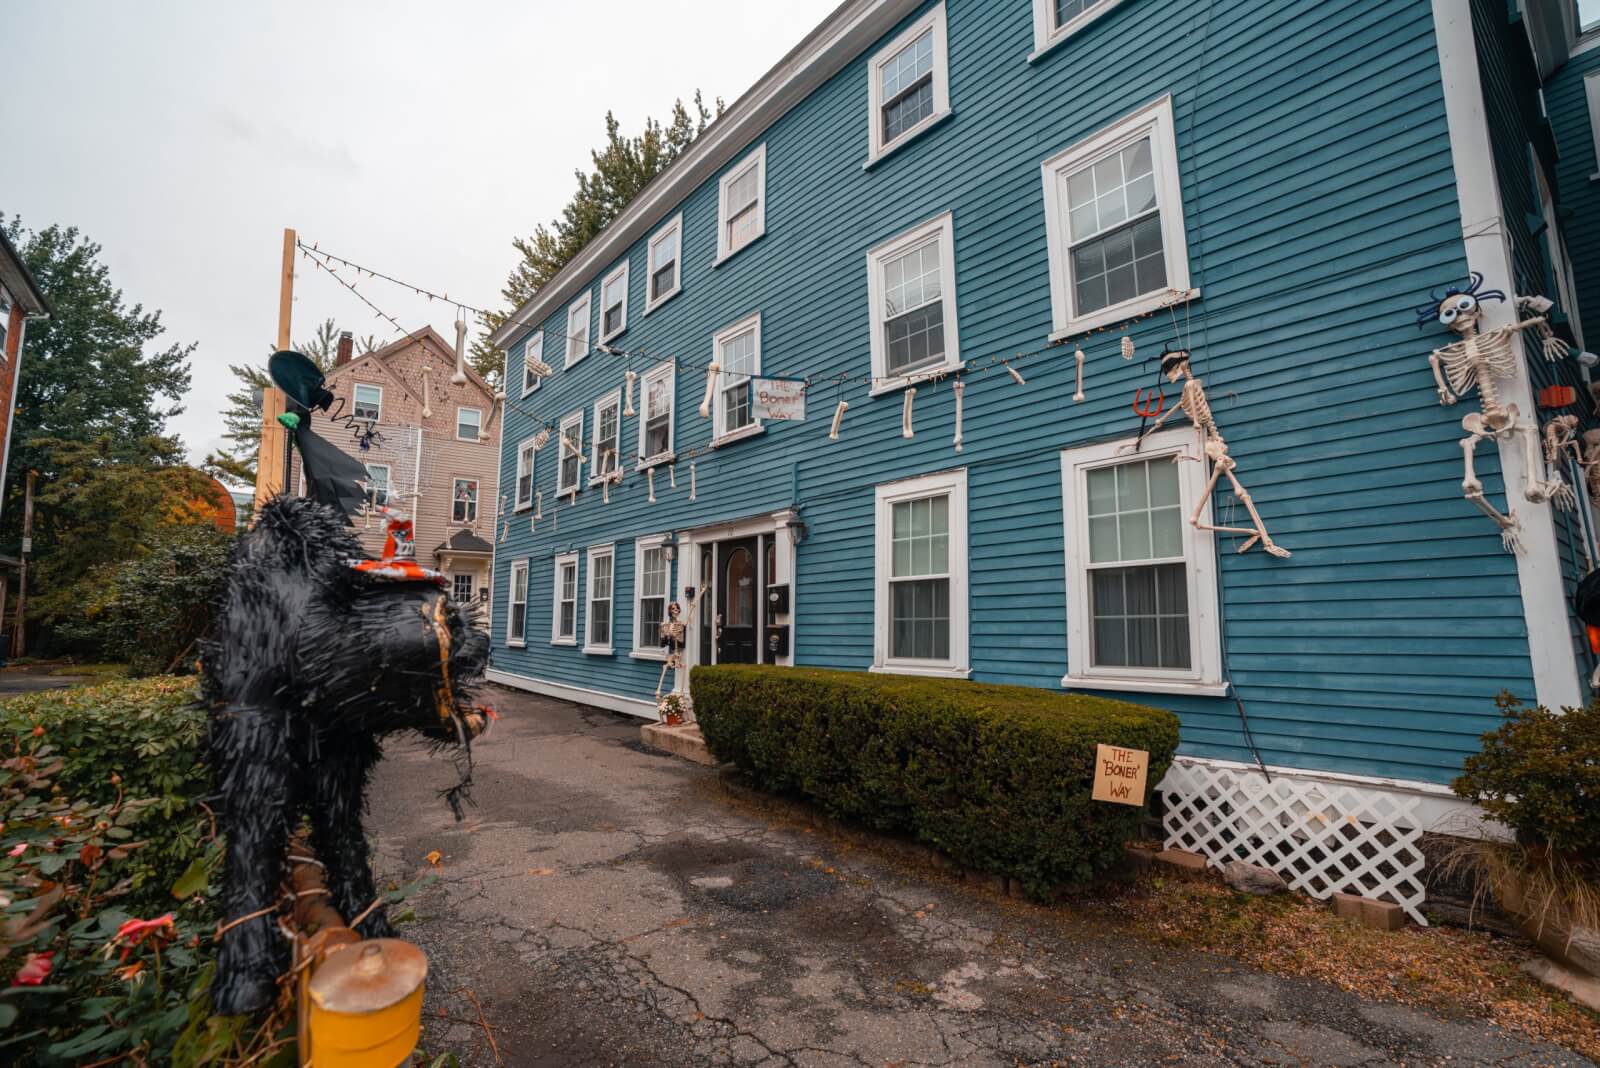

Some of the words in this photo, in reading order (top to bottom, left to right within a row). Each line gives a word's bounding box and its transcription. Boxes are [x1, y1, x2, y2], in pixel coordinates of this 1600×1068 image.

[768, 407, 793, 420] WAY
[1111, 748, 1134, 763] THE
[1110, 780, 1132, 799] WAY
